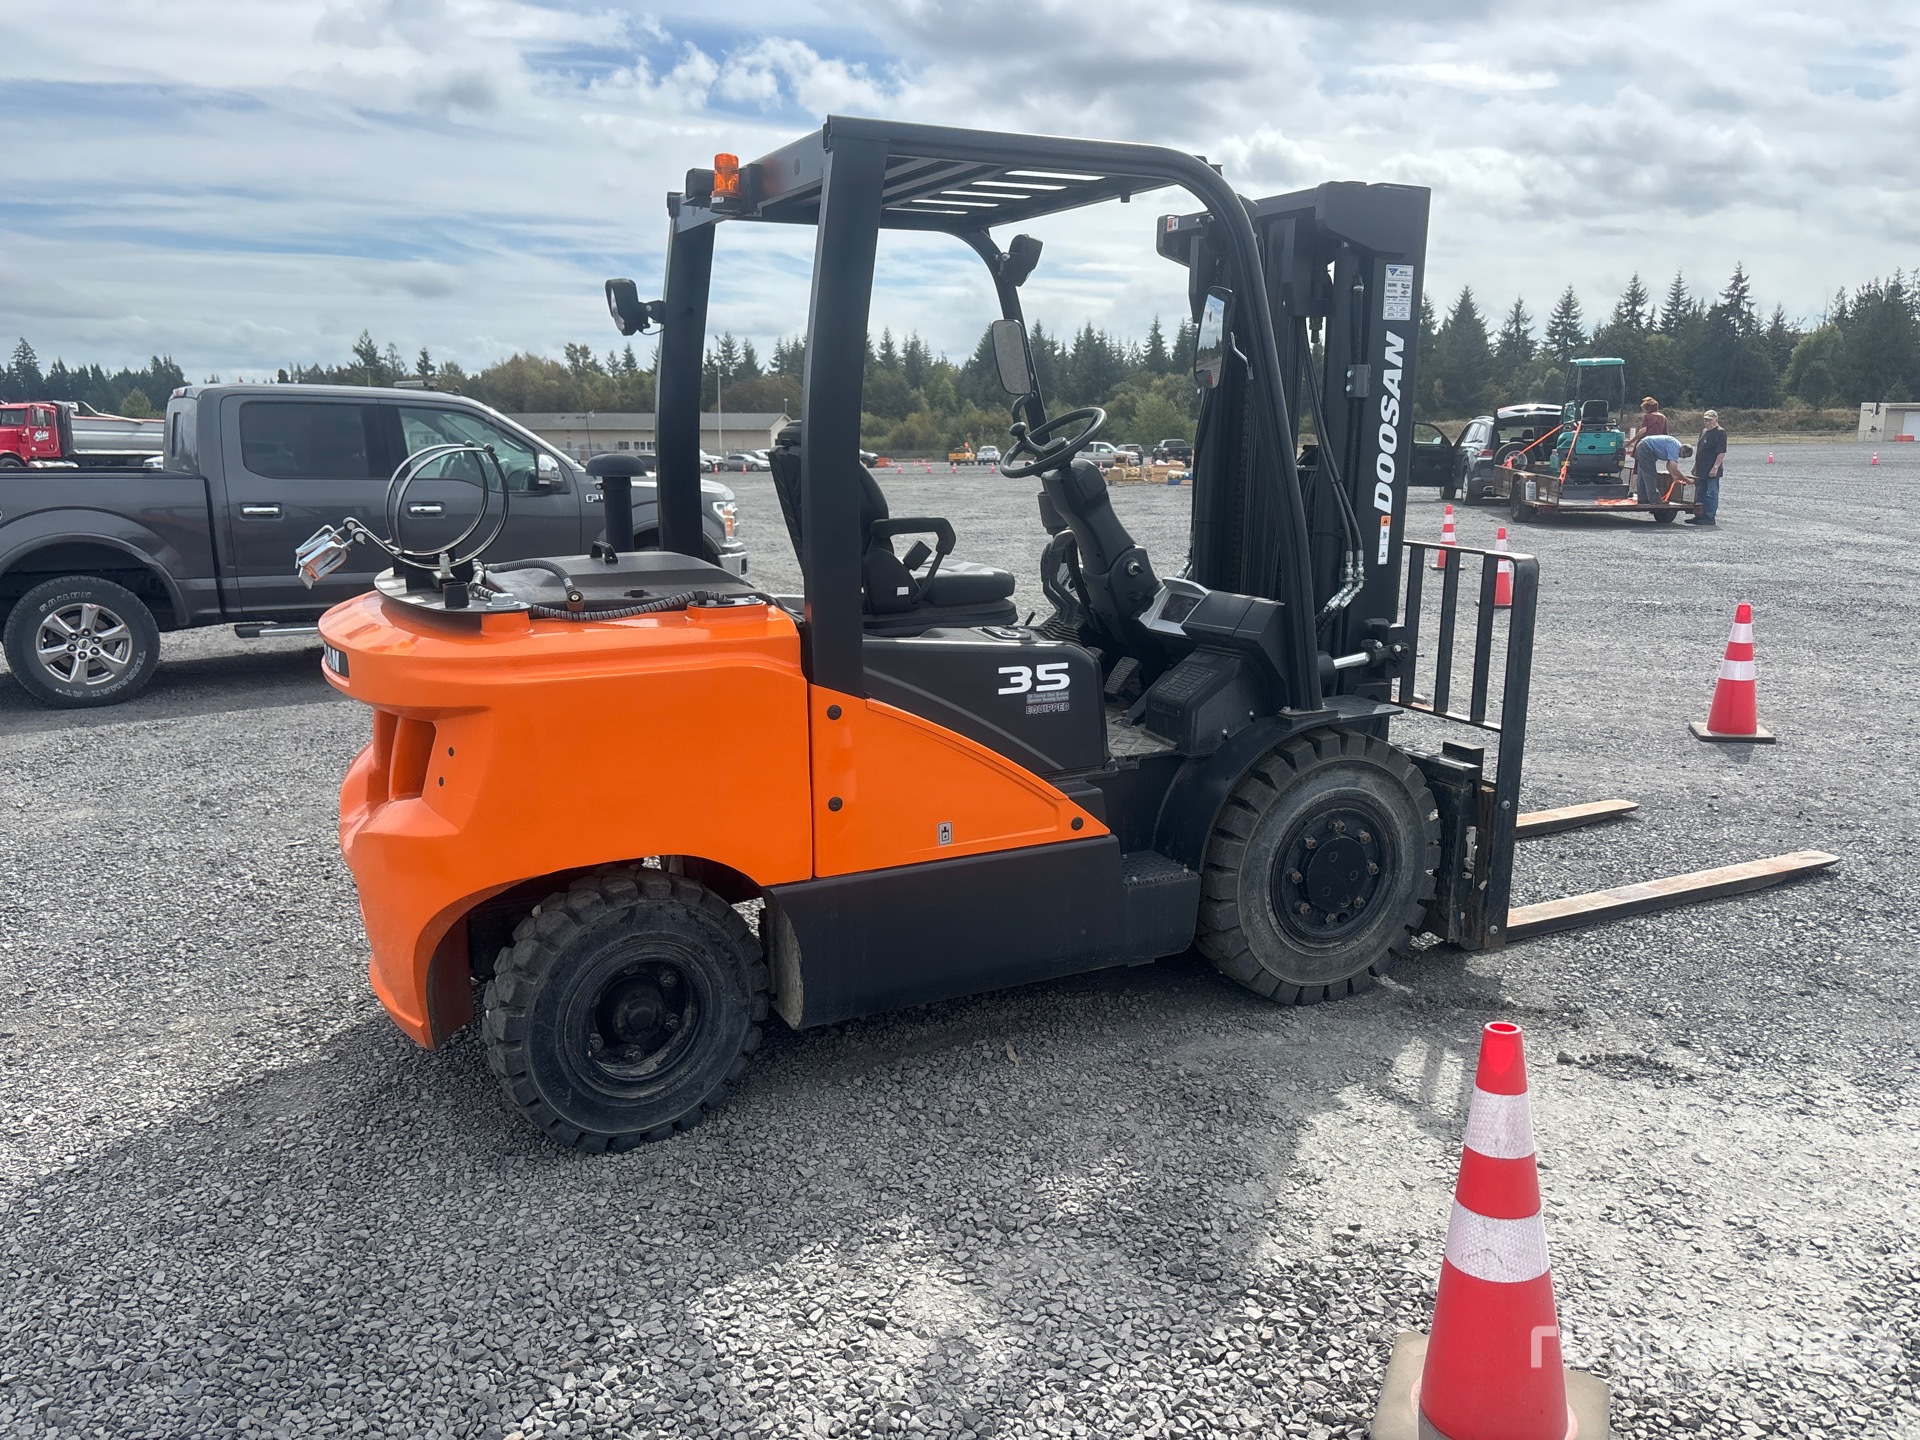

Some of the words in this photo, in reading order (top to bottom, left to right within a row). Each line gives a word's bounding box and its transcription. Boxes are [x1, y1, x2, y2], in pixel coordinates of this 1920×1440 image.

[1374, 330, 1405, 515] DOOSAN
[998, 662, 1071, 695] 35
[1025, 702, 1070, 715] EQUIPPED
